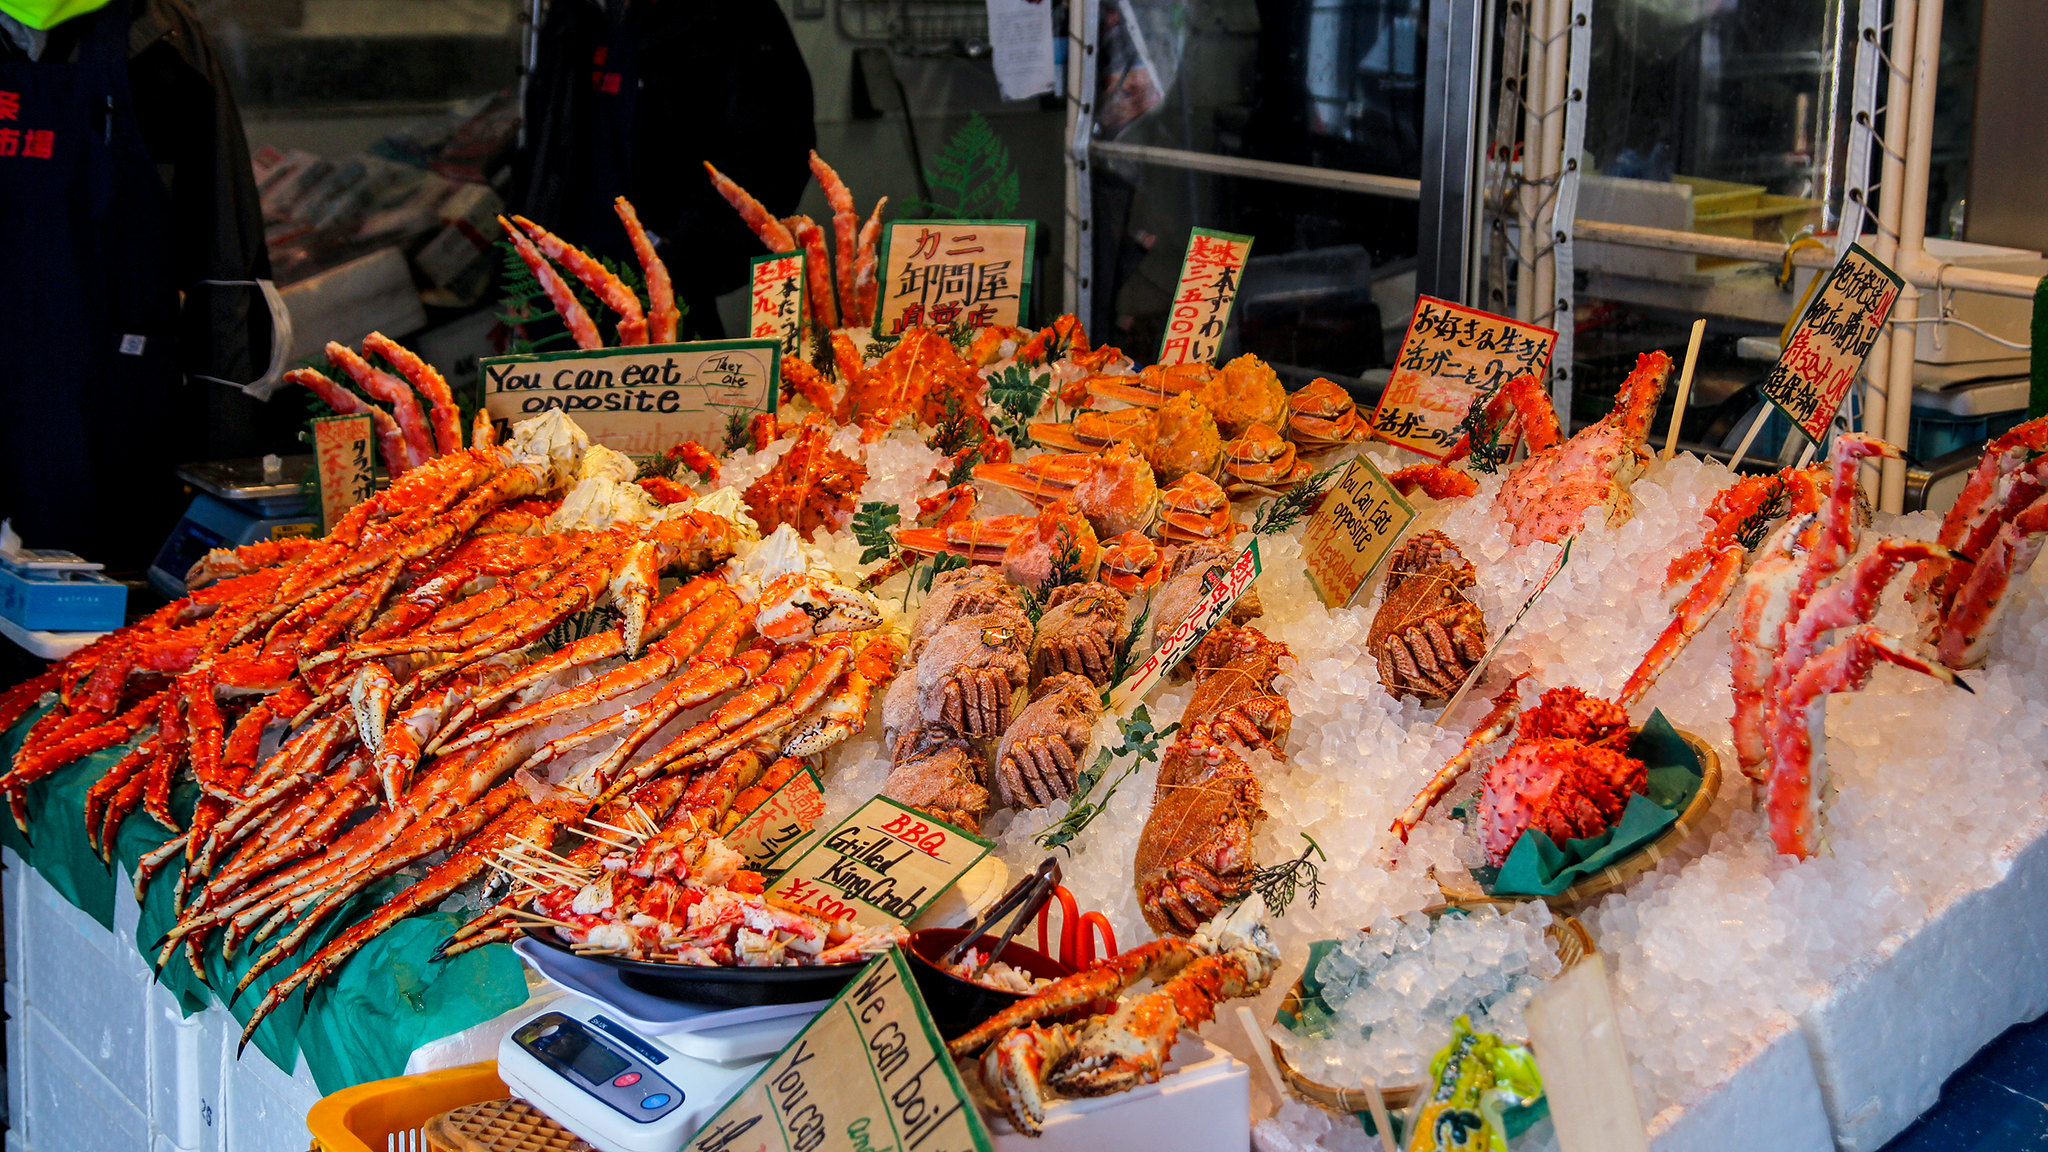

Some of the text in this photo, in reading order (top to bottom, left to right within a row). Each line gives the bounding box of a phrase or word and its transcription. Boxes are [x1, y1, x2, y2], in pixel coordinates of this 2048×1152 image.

[893, 261, 1018, 307] 卸問屋
[890, 301, 998, 336] 直営店
[1192, 266, 1236, 364] 本ずわい
[1413, 303, 1549, 368] お好きな生きた
[486, 364, 541, 392] You
[553, 368, 615, 390] can
[621, 358, 681, 387] eat
[707, 355, 743, 375] They
[521, 389, 680, 414] opposite
[1339, 461, 1393, 536] You Can Eat
[1333, 502, 1373, 553] opposite
[825, 826, 914, 876] Grilled
[881, 812, 946, 857] BBQ
[819, 855, 927, 920] King Crab
[852, 958, 965, 1150] We can boil
[771, 1040, 826, 1152] You can
[696, 1114, 763, 1152] th
